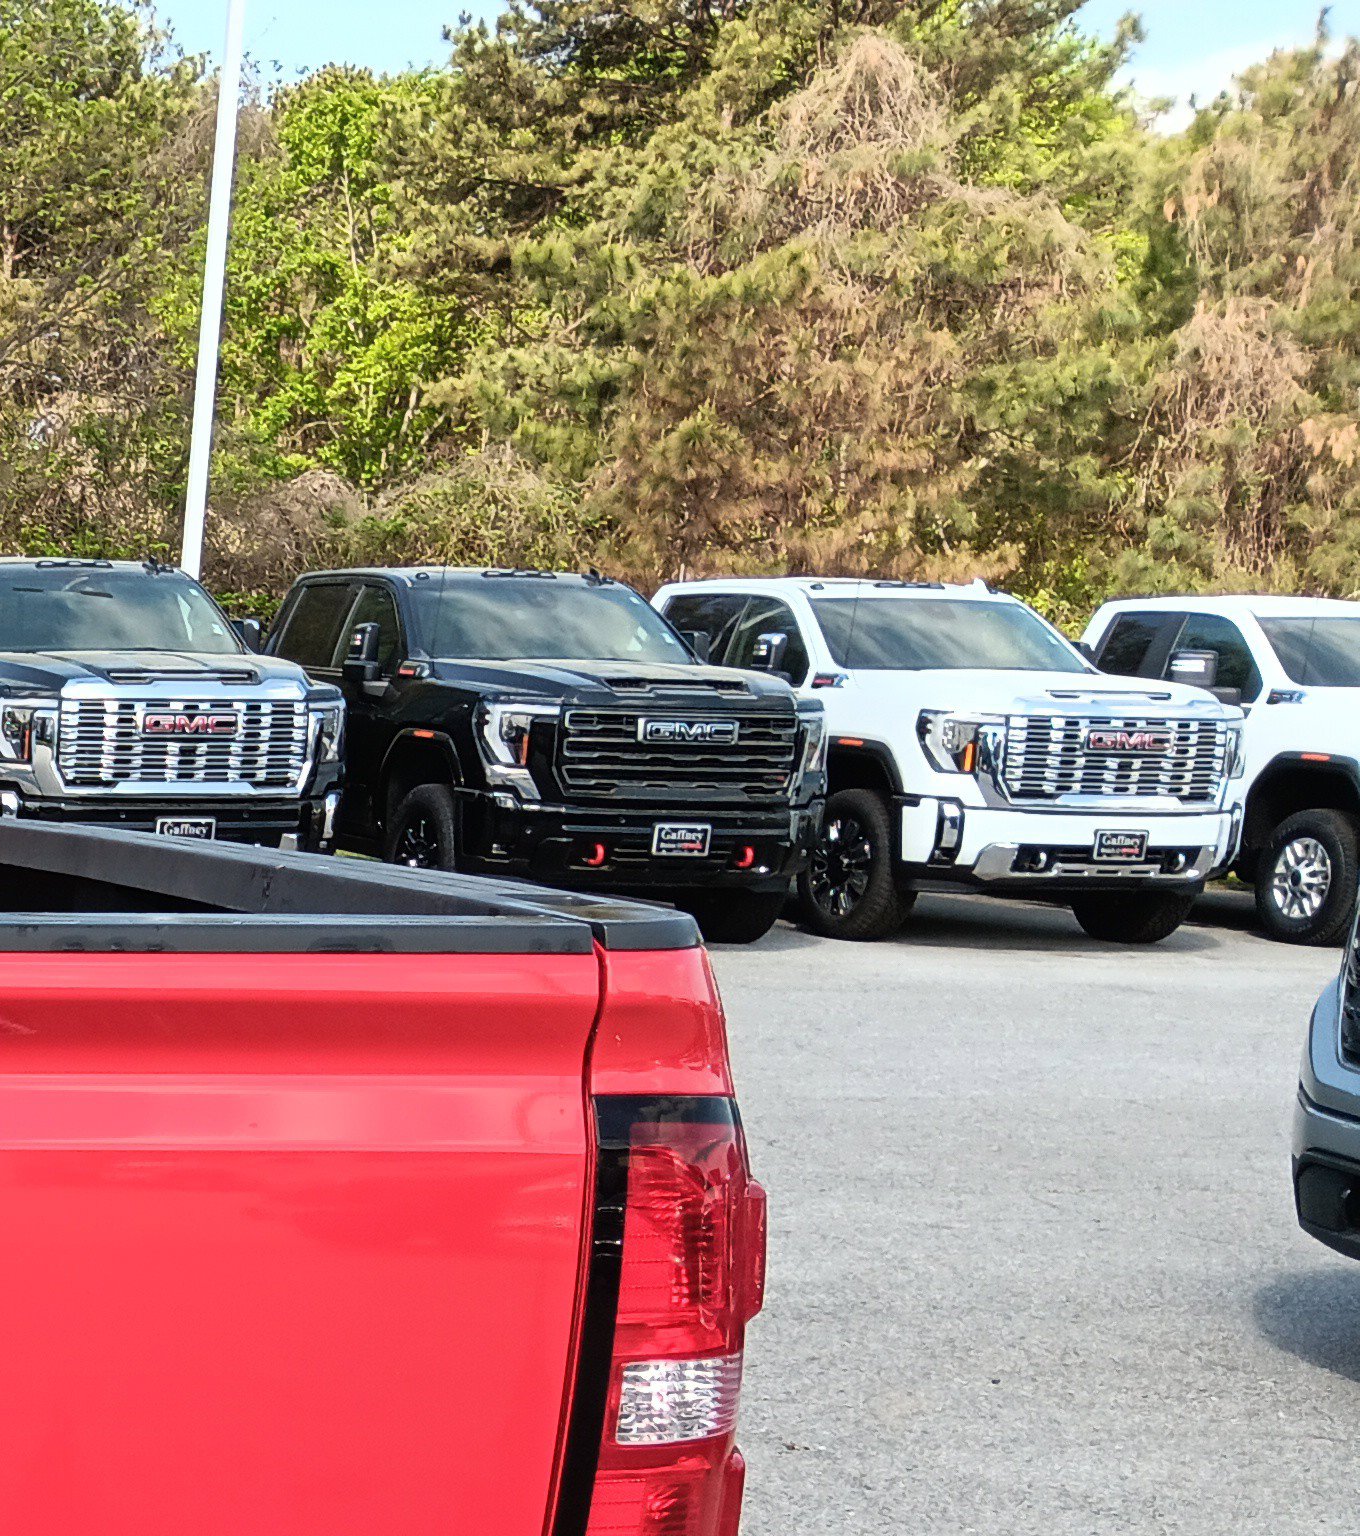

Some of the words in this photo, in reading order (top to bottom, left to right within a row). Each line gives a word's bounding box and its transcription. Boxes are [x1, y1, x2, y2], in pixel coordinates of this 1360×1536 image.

[145, 714, 237, 734] GMC
[646, 721, 735, 742] GMC
[1089, 731, 1172, 751] GMC
